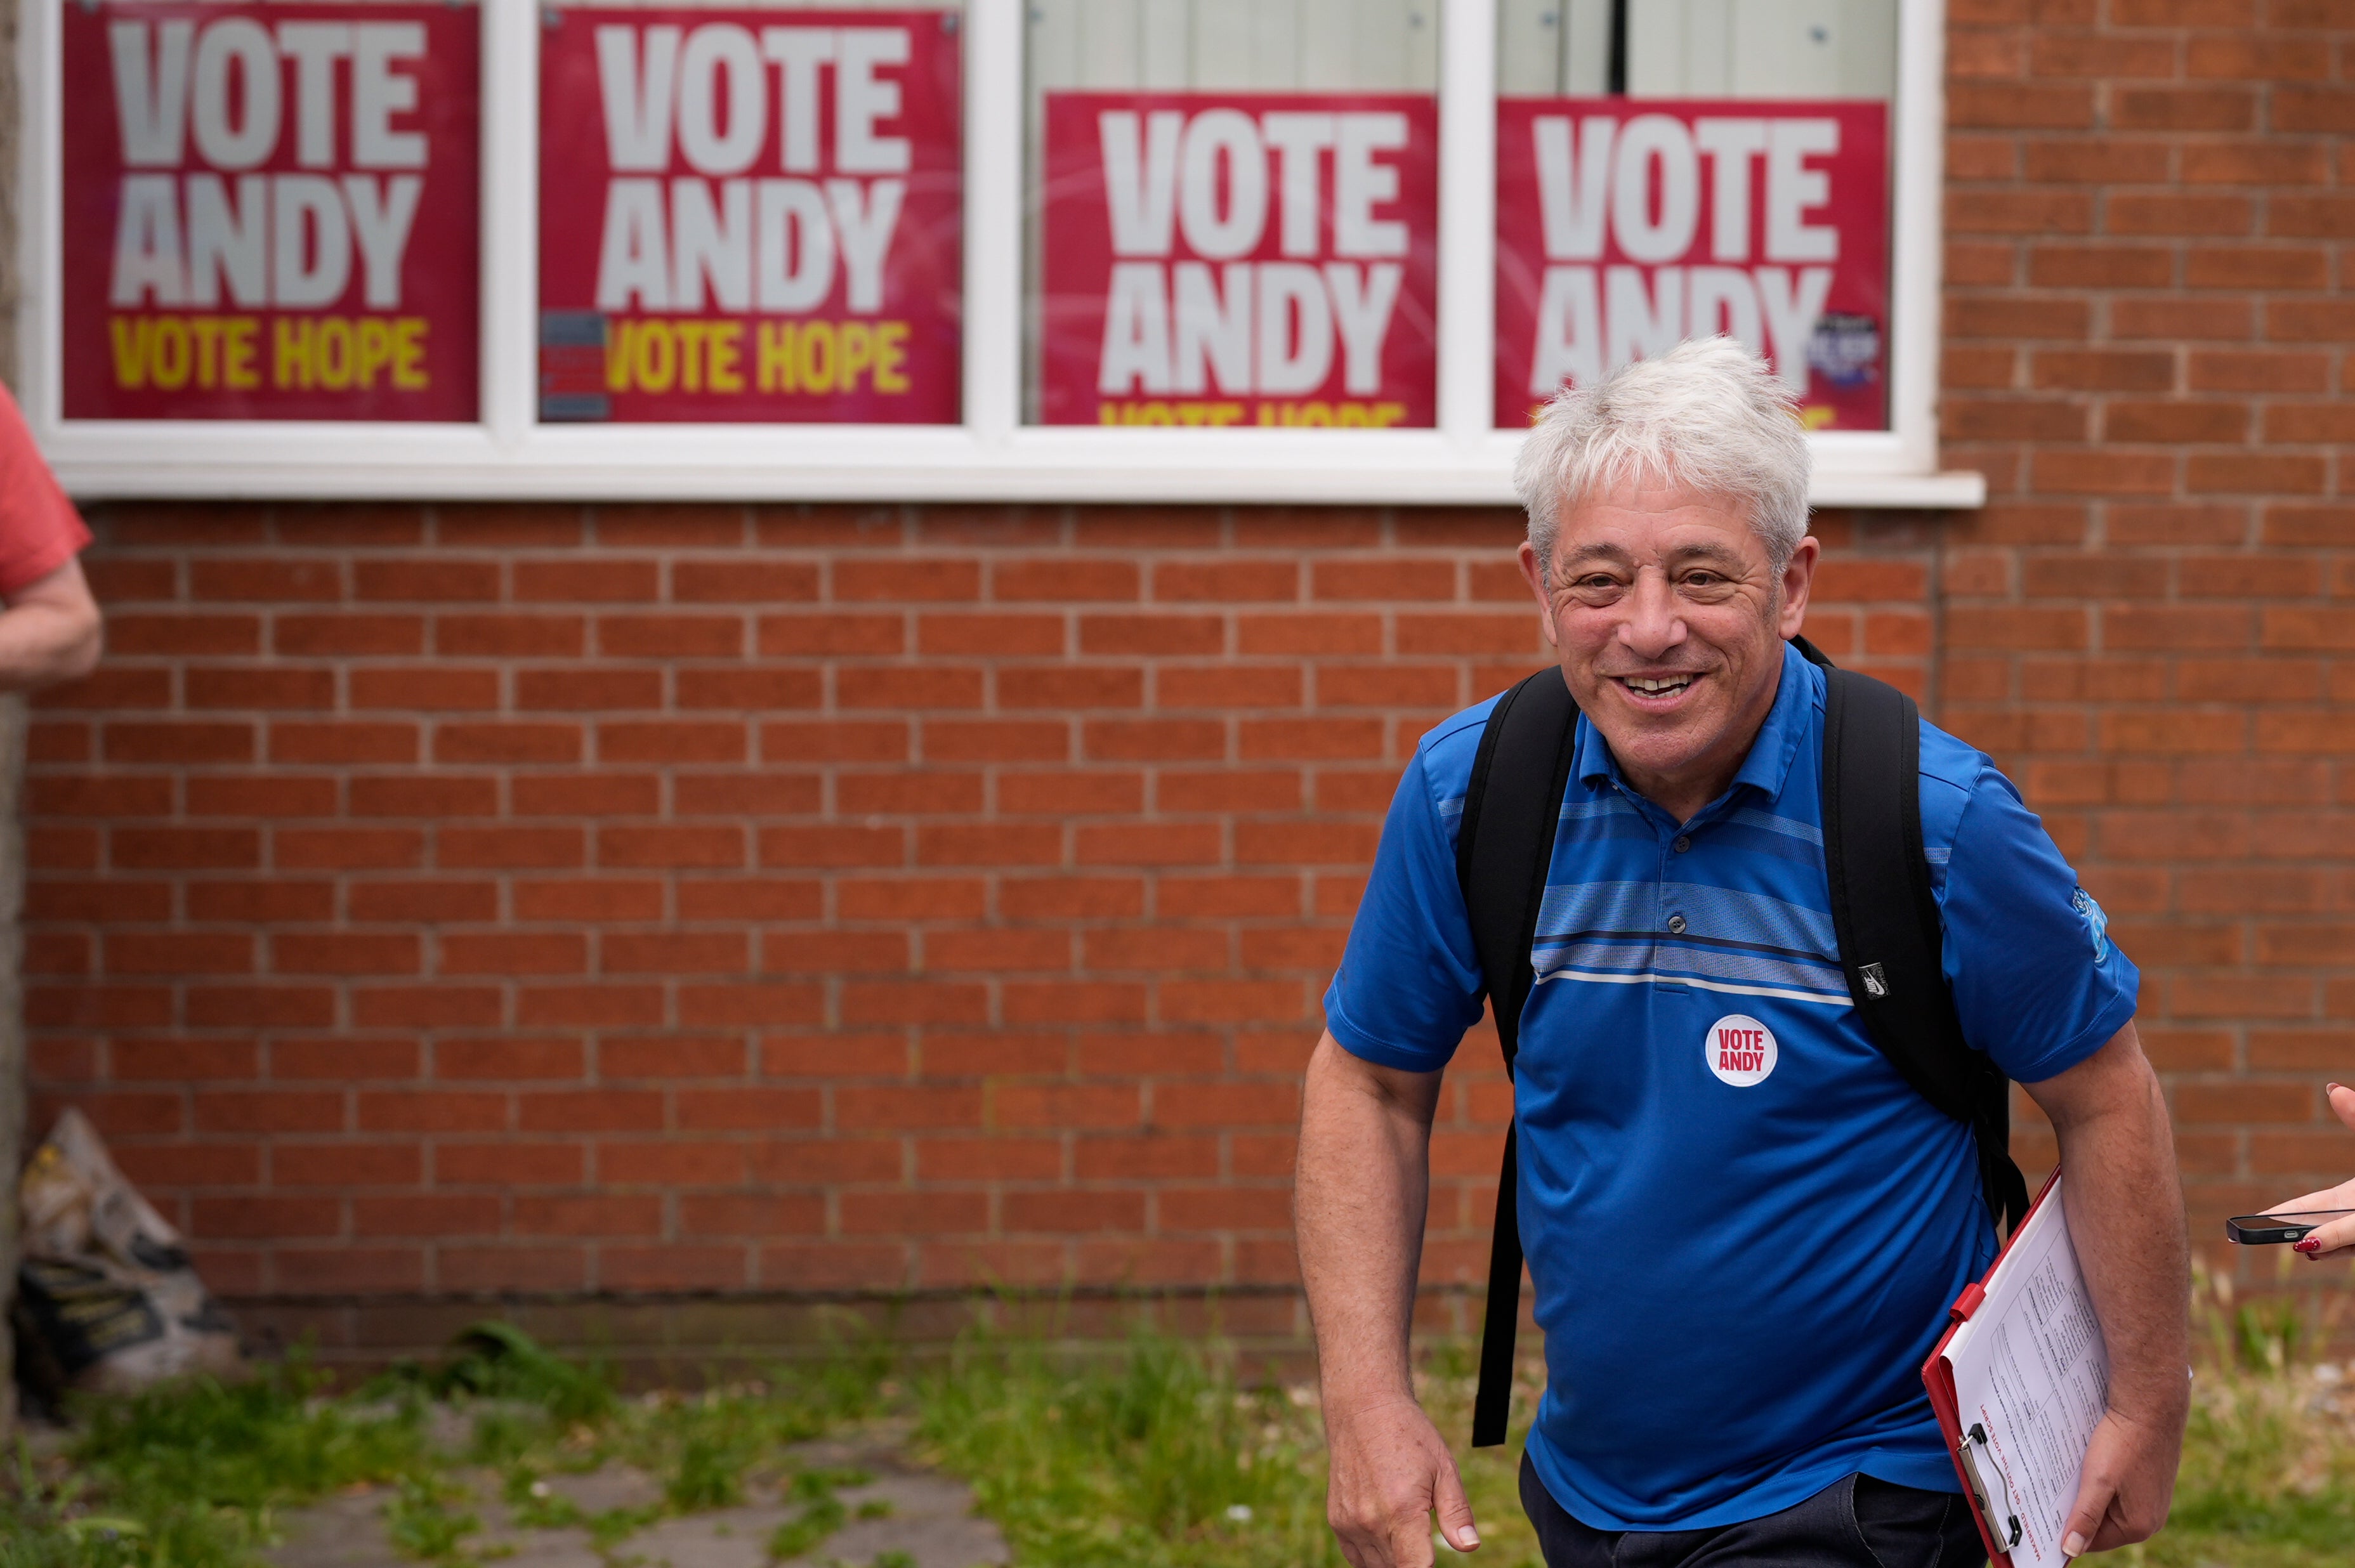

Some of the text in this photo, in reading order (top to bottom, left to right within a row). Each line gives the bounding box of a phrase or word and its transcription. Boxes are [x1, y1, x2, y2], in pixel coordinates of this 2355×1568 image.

[110, 17, 428, 169] VOTE
[596, 24, 911, 174] VOTE
[1099, 109, 1409, 258] VOTE
[1533, 115, 1839, 263] VOTE
[110, 173, 423, 308] ANDY
[596, 178, 907, 313] ANDY
[112, 317, 428, 389] VOTE HOPE
[758, 320, 909, 393] HOPE
[1099, 261, 1403, 395] ANDY
[1863, 977, 1878, 993] NIKE
[1718, 1029, 1764, 1050] VOTE
[1719, 1051, 1764, 1071] ANDY
[1980, 1404, 1993, 1433] SCRIPT
[1991, 1432, 2001, 1454] VOTE
[2012, 1489, 2020, 1505] GET
[2021, 1512, 2041, 1562] MAKERFIELD
